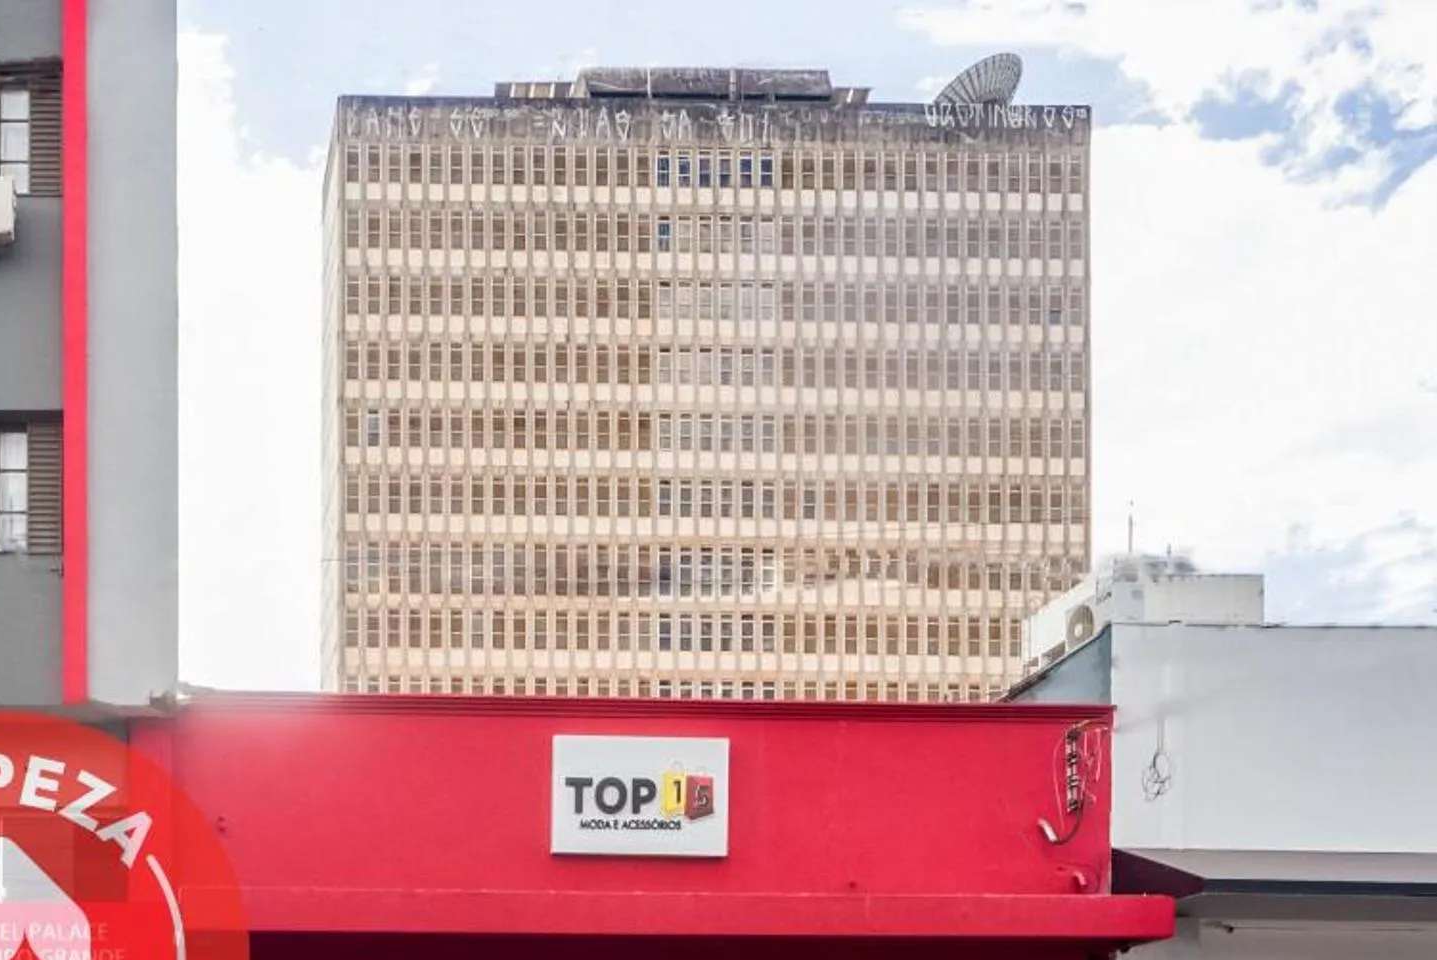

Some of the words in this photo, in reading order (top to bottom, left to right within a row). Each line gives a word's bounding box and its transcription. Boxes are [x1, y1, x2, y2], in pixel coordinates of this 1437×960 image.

[565, 777, 657, 814] TOP
[580, 819, 610, 830] MODA
[29, 922, 109, 941] PALACE
